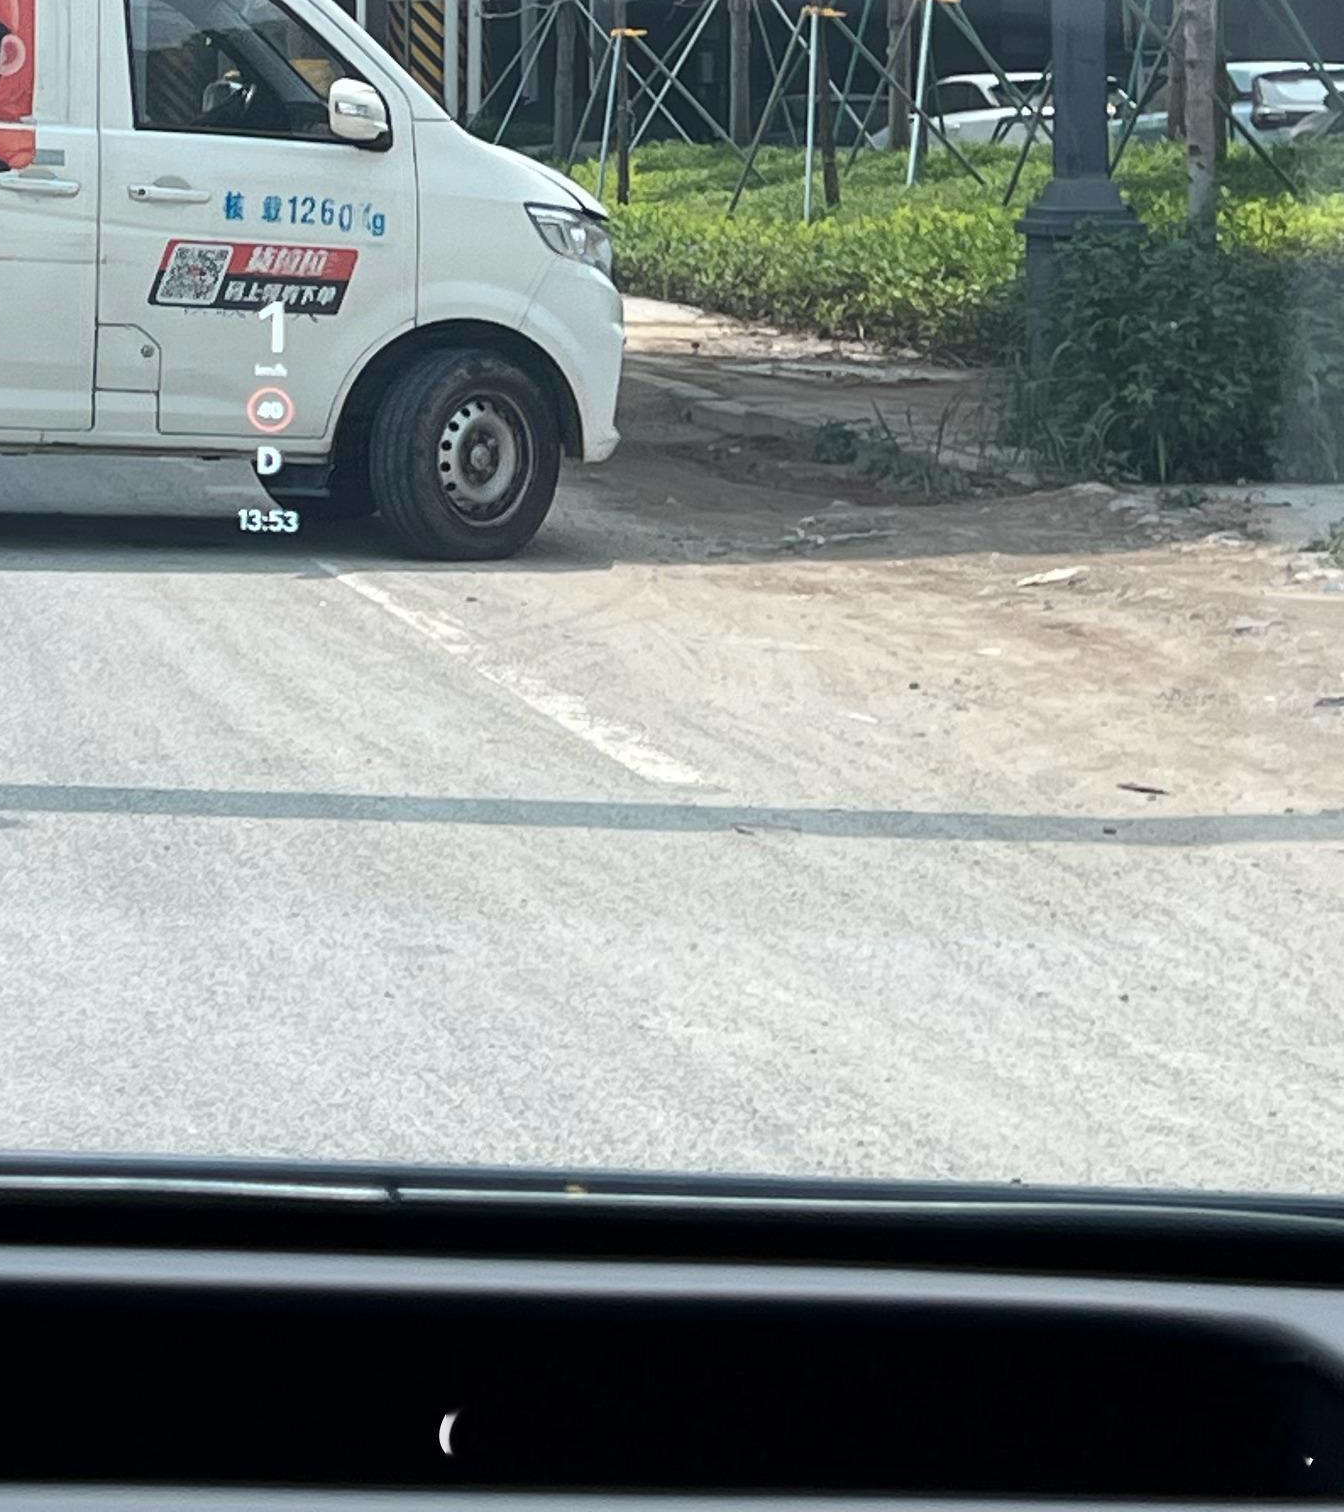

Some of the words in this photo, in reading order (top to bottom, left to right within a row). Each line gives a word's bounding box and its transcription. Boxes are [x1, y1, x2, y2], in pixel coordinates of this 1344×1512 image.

[258, 301, 285, 353] 1
[257, 446, 282, 475] D
[238, 509, 299, 533] 13:53
